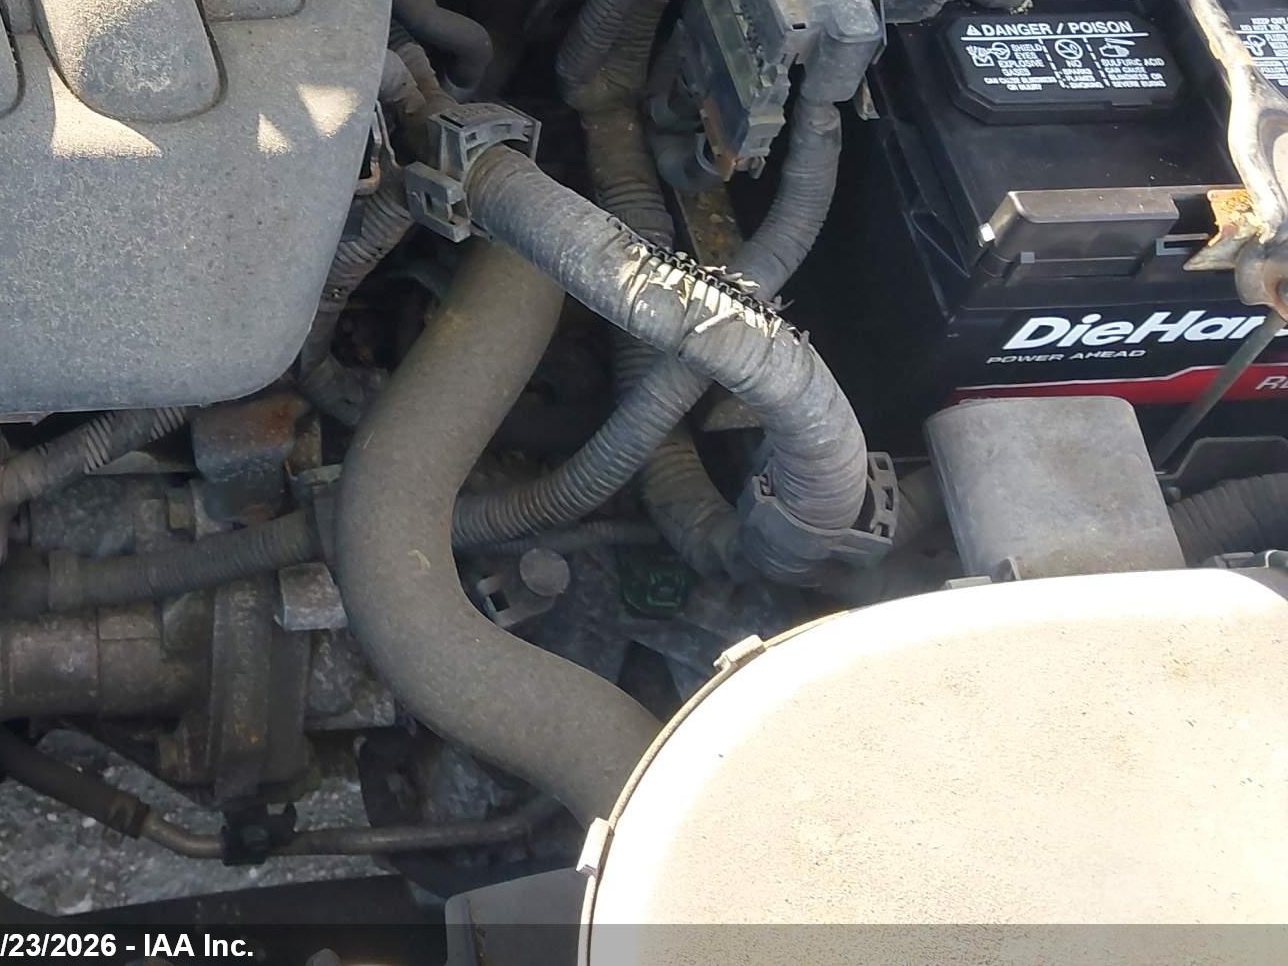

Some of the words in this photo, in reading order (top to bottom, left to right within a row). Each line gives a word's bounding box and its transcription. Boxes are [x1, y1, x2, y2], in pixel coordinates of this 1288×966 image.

[981, 23, 1053, 36] DANGER
[1056, 22, 1064, 34] /
[1067, 21, 1134, 34] POISON
[1010, 43, 1043, 52] SHIELD
[1014, 52, 1039, 60] EYES
[997, 59, 1045, 67] EXPLOSIVE
[1065, 59, 1083, 67] NO
[1100, 58, 1143, 66] SULFURIC
[1144, 57, 1165, 66] ACID
[1001, 68, 1031, 76] GASES
[1104, 66, 1121, 74] CAN
[986, 353, 1065, 365] POWER
[1069, 349, 1146, 361] AHEAD
